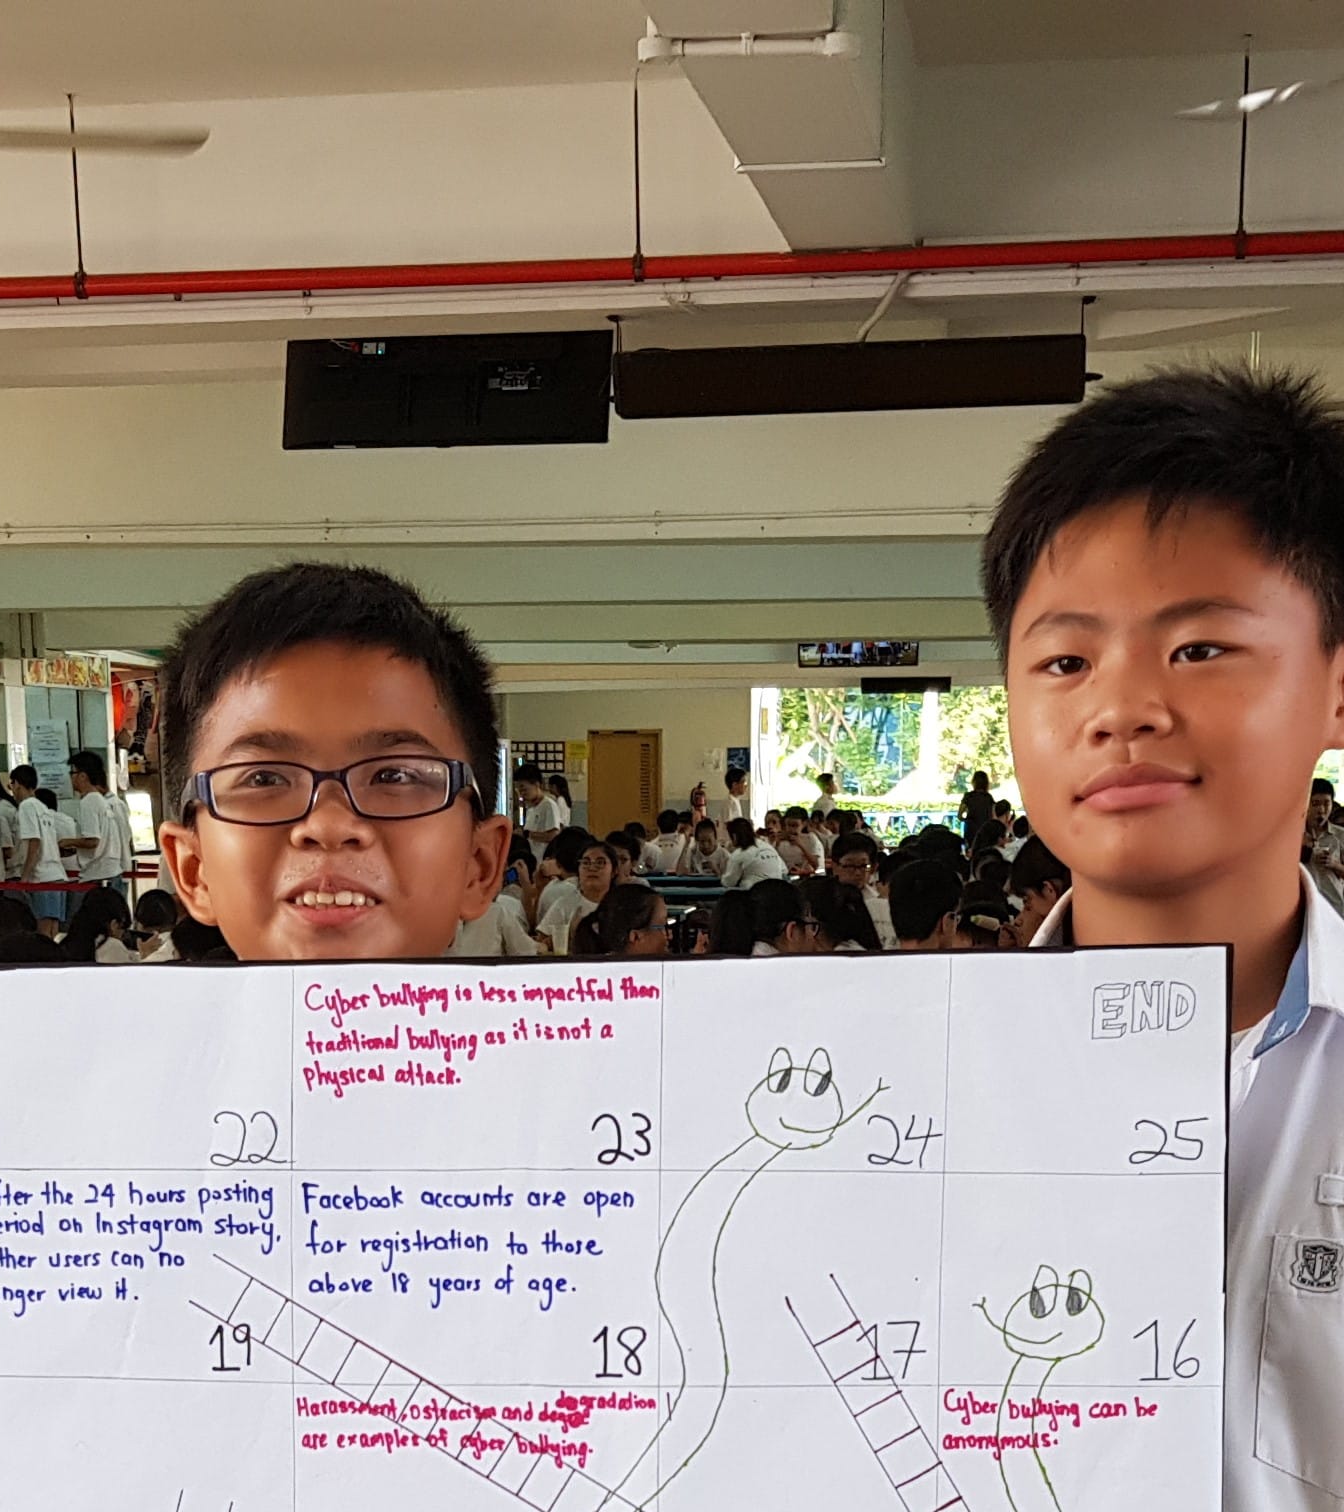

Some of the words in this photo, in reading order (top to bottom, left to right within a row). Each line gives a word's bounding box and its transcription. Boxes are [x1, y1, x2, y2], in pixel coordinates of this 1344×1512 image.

[304, 983, 371, 1029] Cyber
[372, 982, 449, 1017] bullying
[454, 984, 473, 1002] is
[479, 981, 517, 1004] less
[620, 976, 660, 1002] than
[1091, 980, 1197, 1040] END
[405, 1027, 478, 1063] bullying
[484, 1029, 506, 1046] as
[512, 1017, 529, 1041] it
[600, 1022, 614, 1040] a
[302, 1059, 385, 1099] physical
[208, 1109, 290, 1167] 22
[591, 1112, 653, 1165] 23
[867, 1113, 943, 1169] 24
[1127, 1116, 1210, 1165] 25
[39, 1180, 75, 1207] the
[81, 1182, 116, 1207] 24
[127, 1184, 187, 1207] hours
[197, 1181, 275, 1220] posting
[302, 1182, 405, 1214] Facebook
[420, 1185, 515, 1208] accounts
[527, 1190, 567, 1209] are
[582, 1189, 636, 1218] open
[58, 1215, 83, 1235] on
[94, 1214, 204, 1253] Instagram
[305, 1219, 348, 1256] for
[360, 1229, 490, 1272] registration
[505, 1230, 529, 1256] to
[540, 1229, 604, 1256] those
[48, 1249, 101, 1271] users
[110, 1250, 146, 1270] can
[158, 1250, 186, 1270] no
[56, 1281, 104, 1304] view
[308, 1271, 374, 1294] above
[391, 1271, 410, 1294] 18
[429, 1274, 482, 1310] years
[494, 1263, 515, 1295] of
[527, 1276, 578, 1312] age.
[207, 1323, 253, 1374] 19
[592, 1325, 647, 1379] 18
[855, 1319, 928, 1381] 17
[1133, 1318, 1201, 1381] 16
[501, 1401, 533, 1423] and
[942, 1388, 998, 1429] Cyber
[1008, 1388, 1082, 1430] bullying
[1089, 1397, 1128, 1420] can
[1134, 1398, 1159, 1419] be
[301, 1433, 328, 1450] are
[429, 1427, 449, 1449] of
[460, 1430, 506, 1461] cyber
